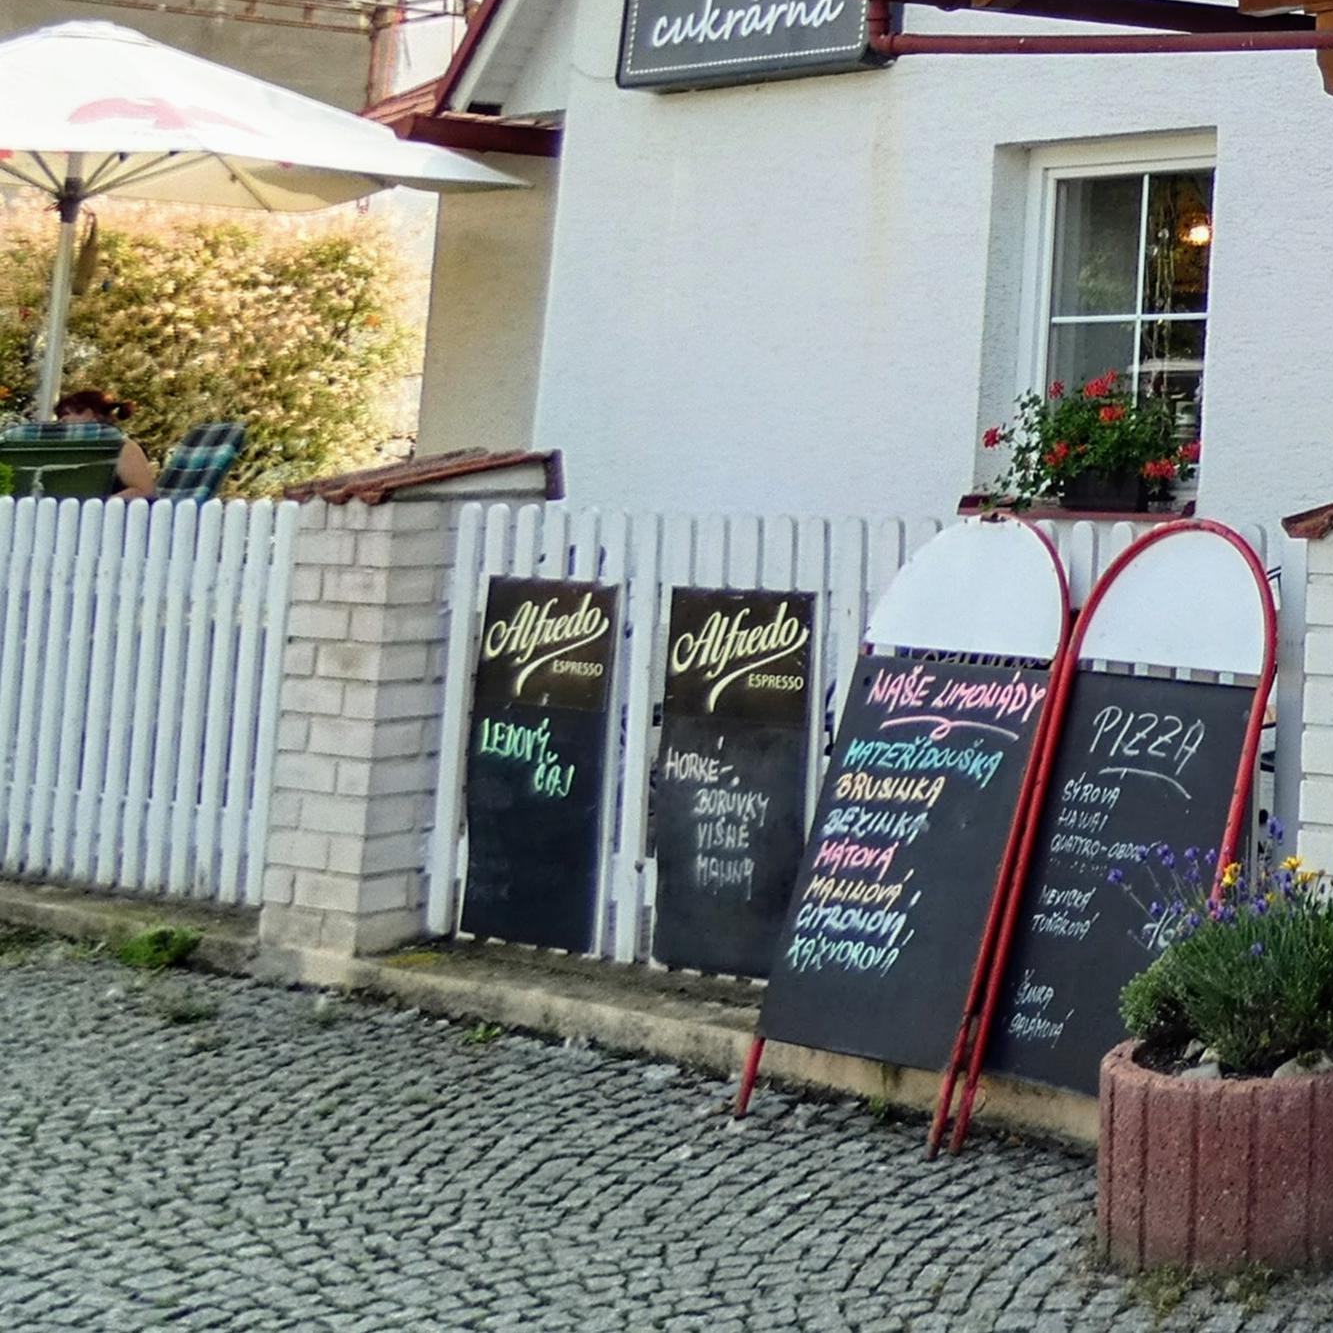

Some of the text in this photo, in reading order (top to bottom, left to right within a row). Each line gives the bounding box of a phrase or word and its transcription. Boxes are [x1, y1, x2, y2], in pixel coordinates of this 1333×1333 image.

[484, 592, 610, 664] Alfredo
[671, 600, 810, 679] Alfredo
[552, 658, 604, 678] ESPRESSO
[747, 673, 805, 691] ESPRESSO
[865, 665, 1047, 723] NAŠE LIMONÁDY
[480, 717, 550, 764] LEDOVÝ
[1090, 705, 1205, 775] PIZZA
